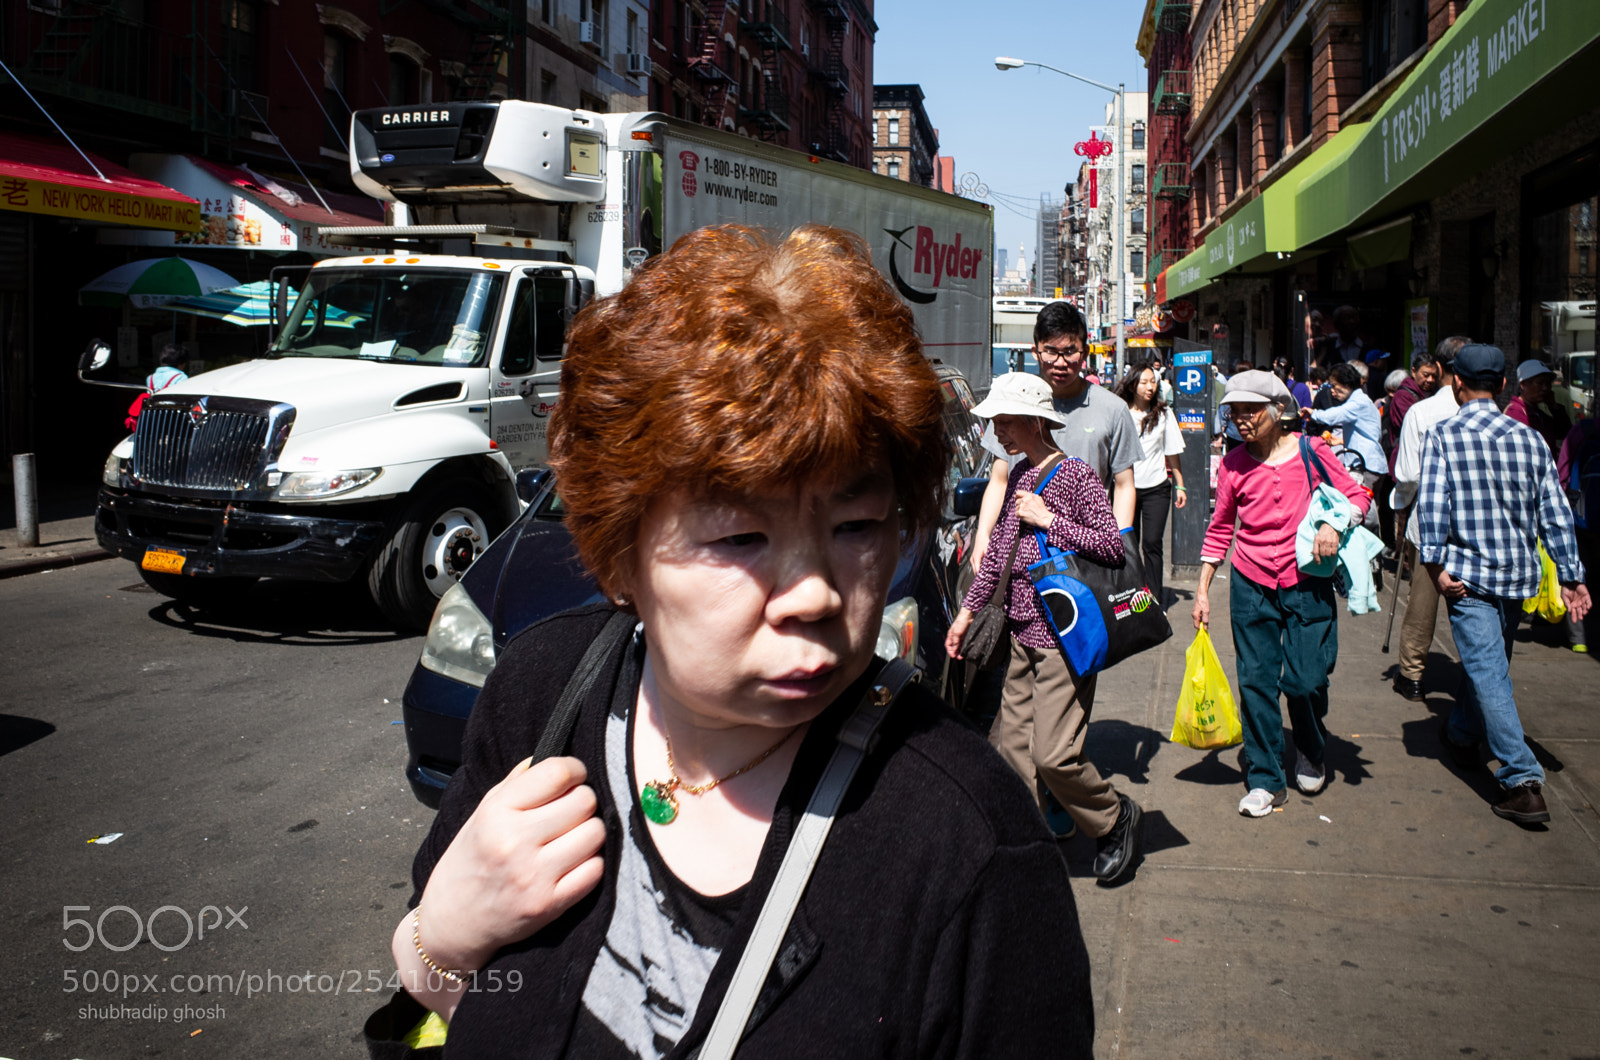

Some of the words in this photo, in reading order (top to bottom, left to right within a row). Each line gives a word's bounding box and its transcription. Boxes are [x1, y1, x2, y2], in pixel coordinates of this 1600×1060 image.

[1393, 84, 1431, 163] FRESH
[1487, 0, 1546, 79] MARKET
[382, 110, 450, 125] CARRIER
[704, 156, 778, 188] 1-800-BY-RYDER
[2, 178, 28, 207] 老
[704, 181, 778, 207] www.ryder.com
[43, 188, 71, 209] NEW
[73, 193, 105, 214] YORK
[108, 198, 142, 218] HELLO
[144, 203, 172, 222] MART
[174, 208, 196, 225] INC.
[588, 211, 619, 223] 626239
[914, 225, 982, 287] Ryder
[1186, 369, 1201, 390] P
[540, 402, 557, 414] Ryd
[497, 433, 522, 445] GARDEN
[523, 432, 537, 442] CITY
[509, 423, 535, 434] DENTON
[1113, 602, 1130, 615] 2012
